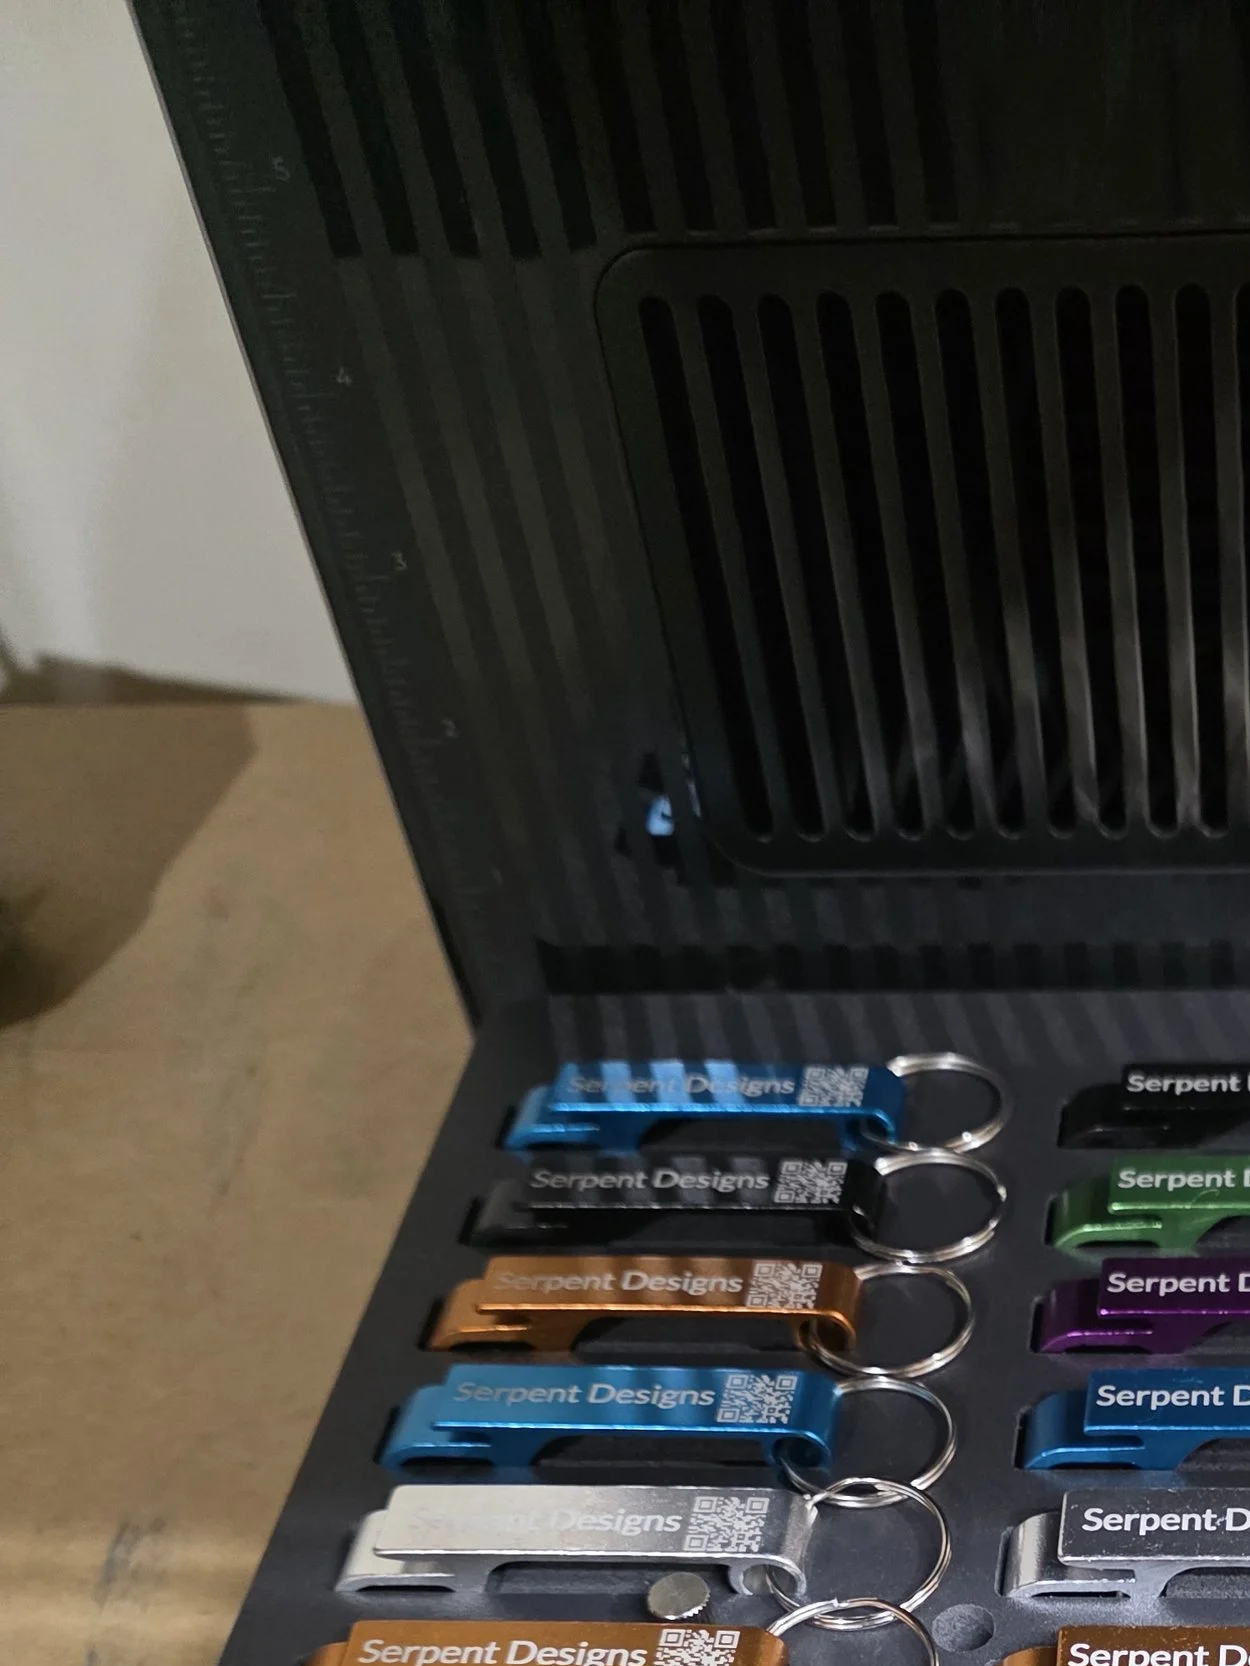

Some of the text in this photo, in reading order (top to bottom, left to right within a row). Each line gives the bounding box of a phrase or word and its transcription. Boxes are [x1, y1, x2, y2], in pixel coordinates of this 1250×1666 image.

[684, 1074, 795, 1098] Designs
[1126, 1074, 1241, 1095] Serpent
[529, 1169, 770, 1193] Serpent Designs
[1118, 1168, 1235, 1191] Serpent
[495, 1270, 743, 1295] Serpent Designs
[1107, 1272, 1230, 1296] Serpent
[454, 1382, 715, 1409] Serpent Designs
[1096, 1386, 1224, 1410] Serpent
[552, 1508, 682, 1537] Designs
[1082, 1508, 1217, 1535] Serpent
